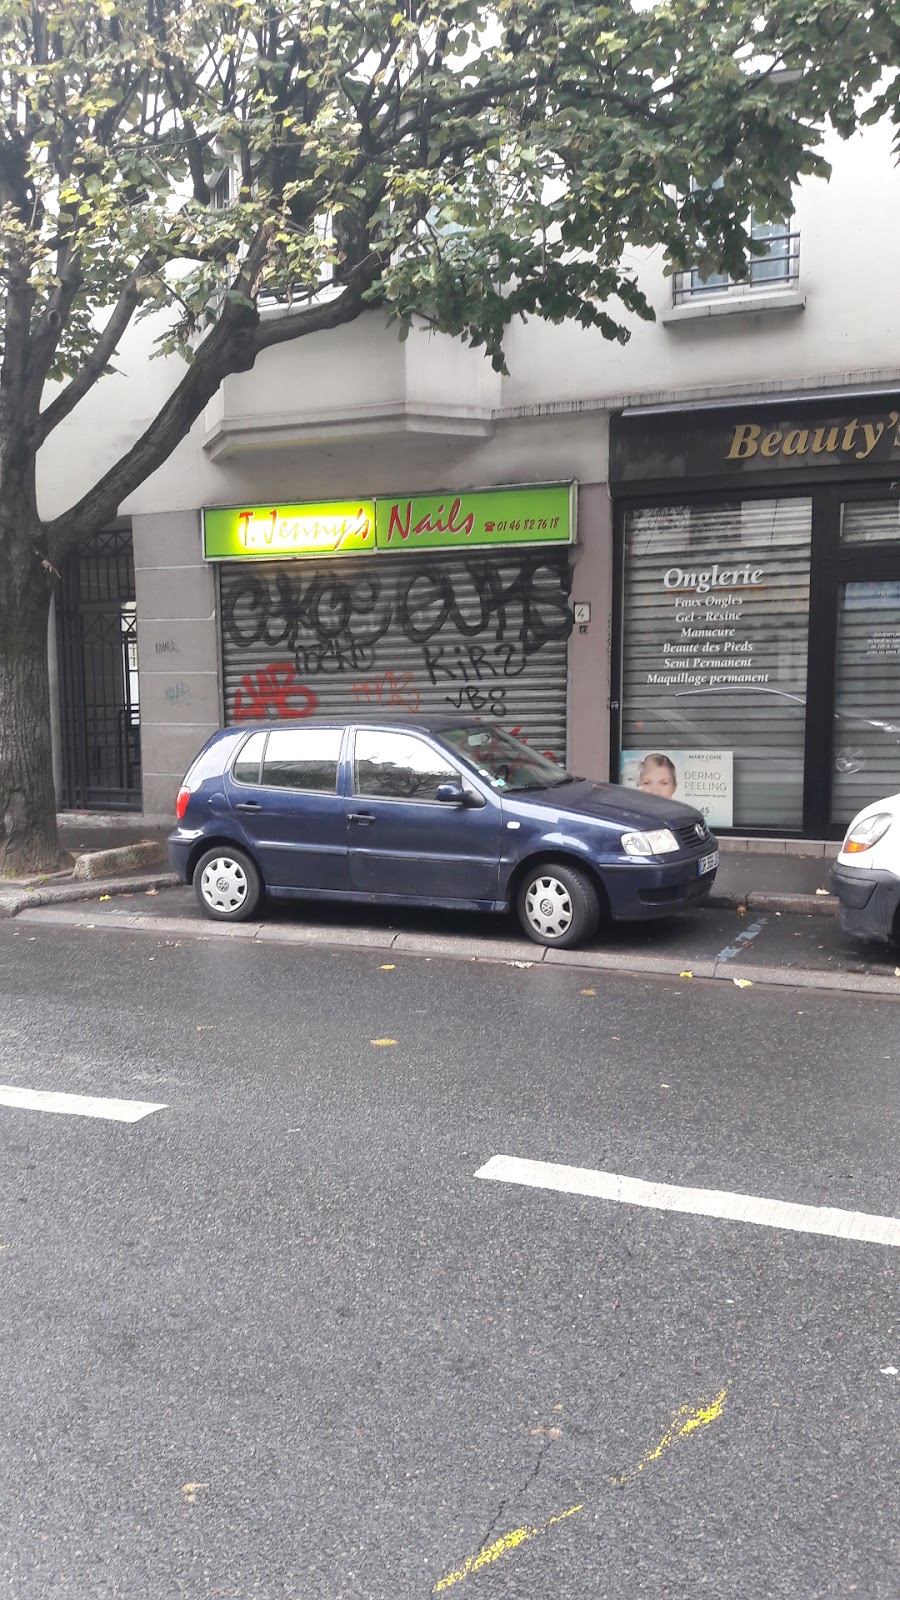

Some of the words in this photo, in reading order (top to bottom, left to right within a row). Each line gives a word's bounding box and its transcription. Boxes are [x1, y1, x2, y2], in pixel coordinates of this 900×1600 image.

[239, 511, 256, 547] T.
[264, 508, 372, 551] Jenny's
[387, 498, 475, 543] Nails
[663, 564, 764, 593] Onglerie
[674, 597, 702, 608] Faux
[705, 594, 743, 608] Ongles
[675, 611, 695, 623] Gel
[705, 610, 742, 622] Résine
[680, 627, 736, 638] Manucure
[662, 642, 700, 653] Beauté
[702, 641, 721, 652] des
[723, 640, 753, 652] Pieds
[662, 658, 690, 669] Semi
[692, 657, 752, 669] Permanent
[646, 672, 707, 687] Maquillage
[709, 673, 769, 685] permanent
[684, 771, 721, 781] DERMO
[684, 781, 727, 791] PEELING
